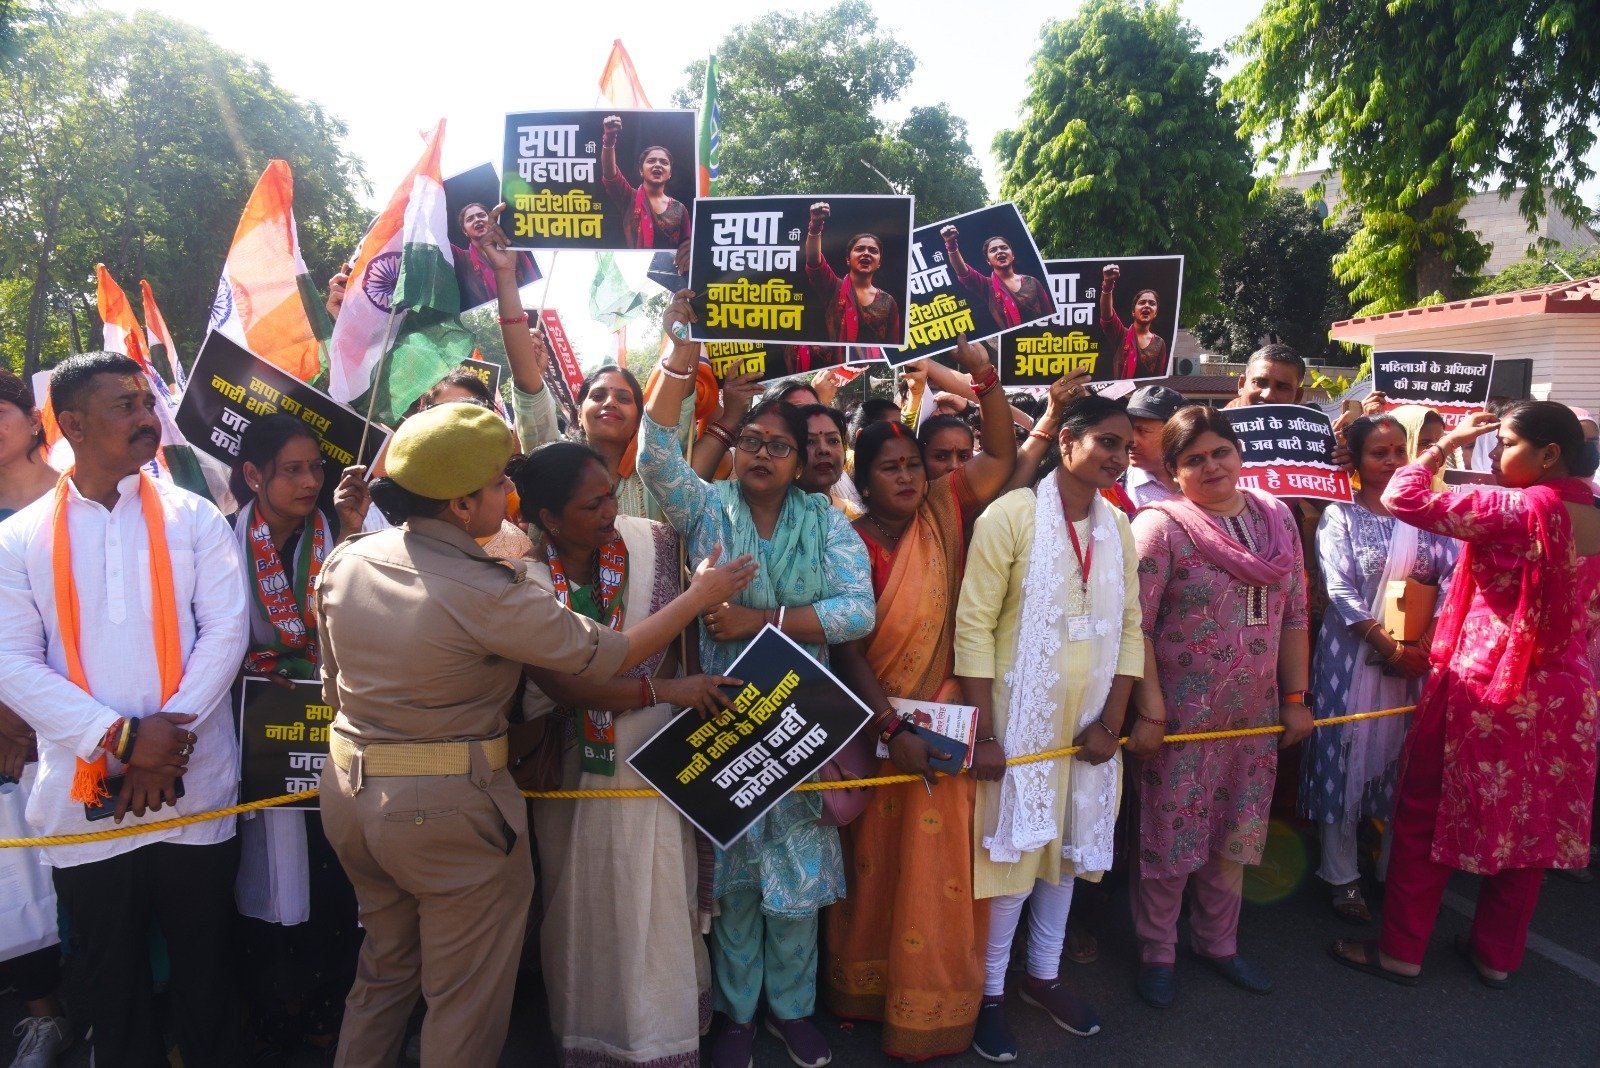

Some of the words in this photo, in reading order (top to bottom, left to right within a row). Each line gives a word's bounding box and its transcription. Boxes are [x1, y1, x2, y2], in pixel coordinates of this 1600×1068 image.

[517, 125, 580, 157] सपा
[585, 141, 596, 154] की
[517, 158, 597, 183] पहचान
[514, 188, 592, 212] नारीशक्ति
[514, 212, 603, 239] अपमान
[711, 212, 784, 245] सपा
[788, 228, 801, 241] की
[711, 245, 800, 272] पहचान
[932, 250, 944, 263] की
[707, 277, 793, 303] नारीशक्ति
[793, 293, 803, 302] का
[1085, 287, 1096, 299] की
[706, 303, 805, 331] अपमान
[908, 293, 957, 325] रीशक्ति
[1015, 331, 1090, 353] नारीशक्ति
[1014, 353, 1099, 376] अपमान
[1380, 360, 1427, 373] महिलाओं
[1430, 360, 1441, 374] के
[1444, 362, 1488, 376] अधिकारों
[211, 374, 247, 404] नारी
[1394, 377, 1408, 390] की
[1412, 380, 1428, 391] जब
[1431, 380, 1451, 392] बारी
[1453, 381, 1473, 394] आई
[248, 376, 281, 403] सपा
[281, 394, 303, 416] का
[301, 407, 332, 433] हाथ
[1231, 417, 1265, 433] लाओं
[1268, 416, 1283, 430] के
[1288, 417, 1331, 437] अधिकारों
[1251, 438, 1273, 451] जब
[1276, 436, 1302, 450] बारी
[1306, 439, 1327, 455] आई
[1265, 469, 1281, 489] है
[676, 752, 711, 785] नारी
[706, 730, 740, 760] शक्ति
[733, 720, 754, 736] के
[747, 669, 800, 726] खिलाफ
[686, 721, 718, 748] सपा
[732, 682, 761, 714] हाथ
[264, 721, 306, 741] नारी
[711, 741, 772, 790] जनता
[763, 703, 808, 749] नहीं
[729, 757, 789, 809] करेगी
[780, 722, 829, 767] माफ
